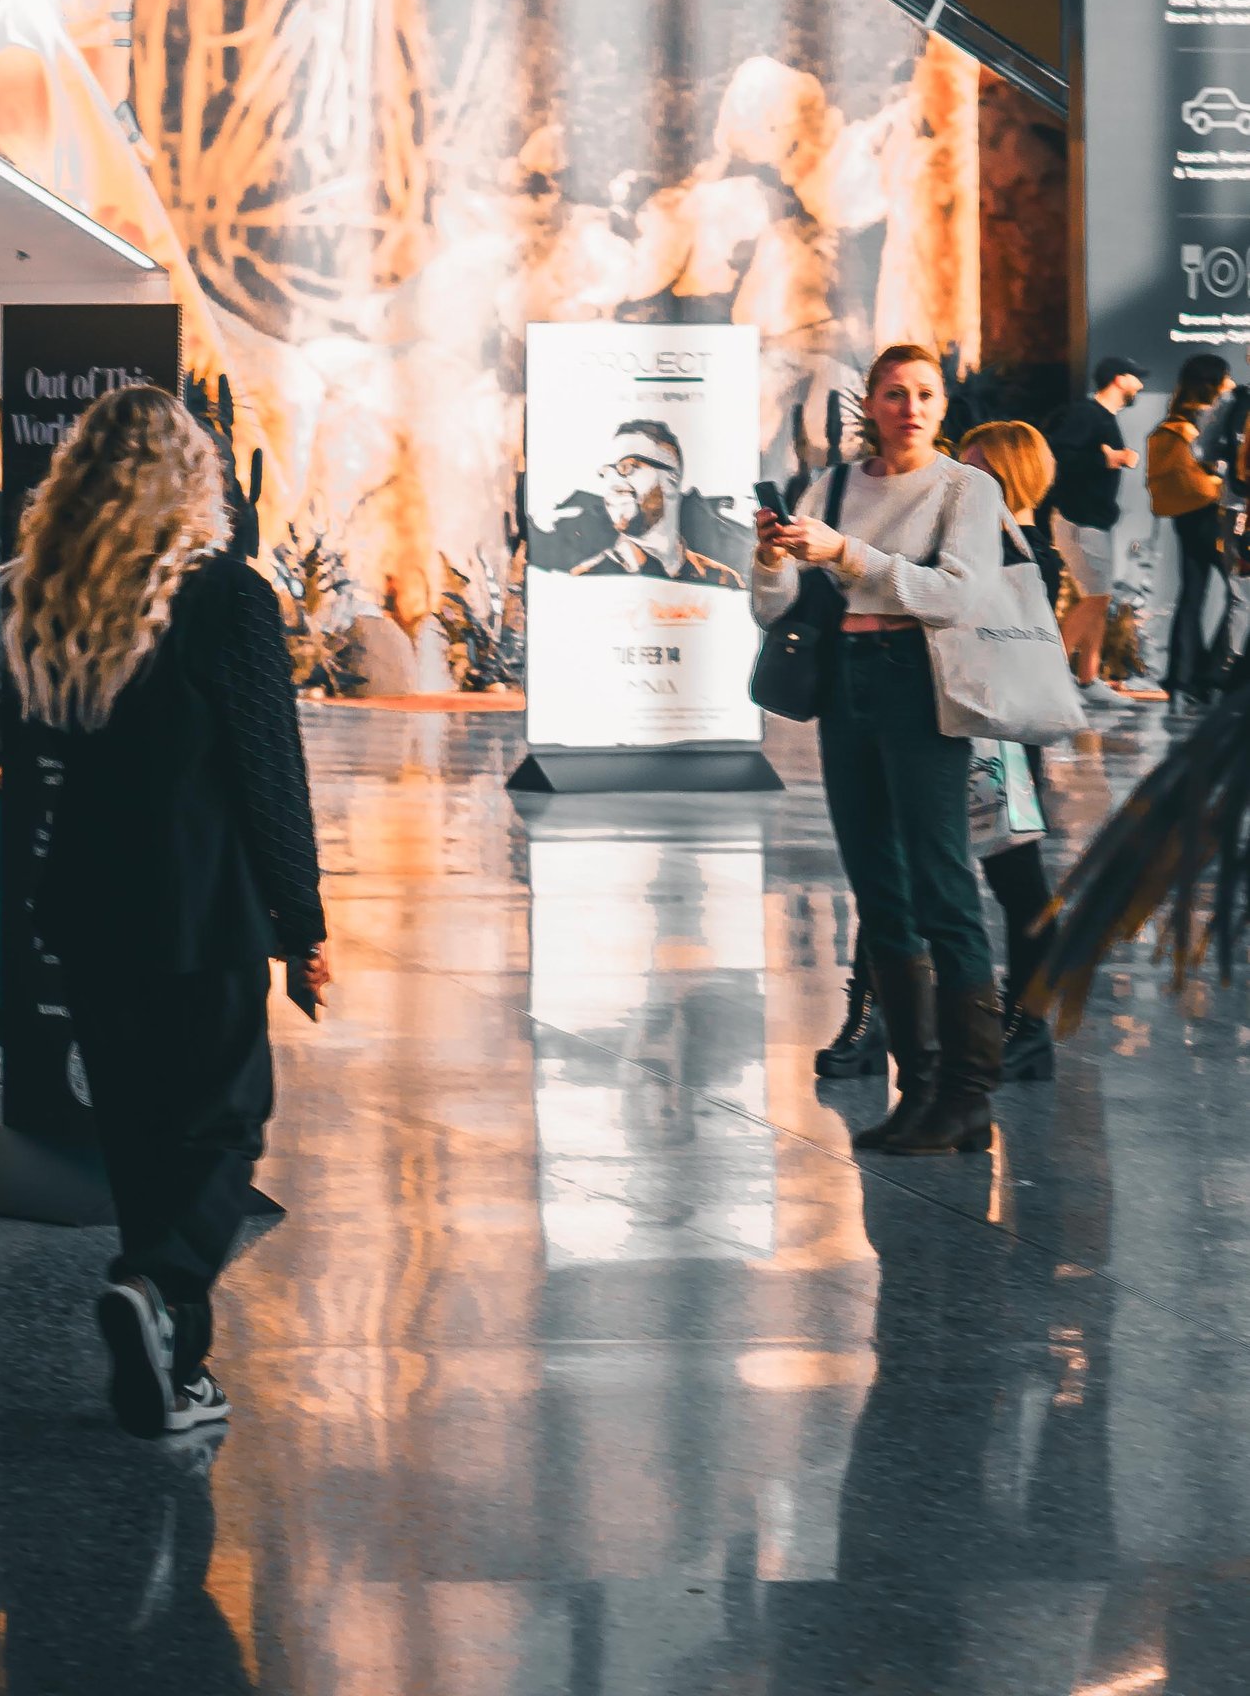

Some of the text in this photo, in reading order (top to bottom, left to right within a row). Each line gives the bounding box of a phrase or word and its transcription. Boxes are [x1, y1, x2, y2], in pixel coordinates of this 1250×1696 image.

[577, 351, 712, 373] ROJECT
[25, 367, 67, 399] Out
[72, 367, 99, 399] of
[11, 414, 81, 445] Worl
